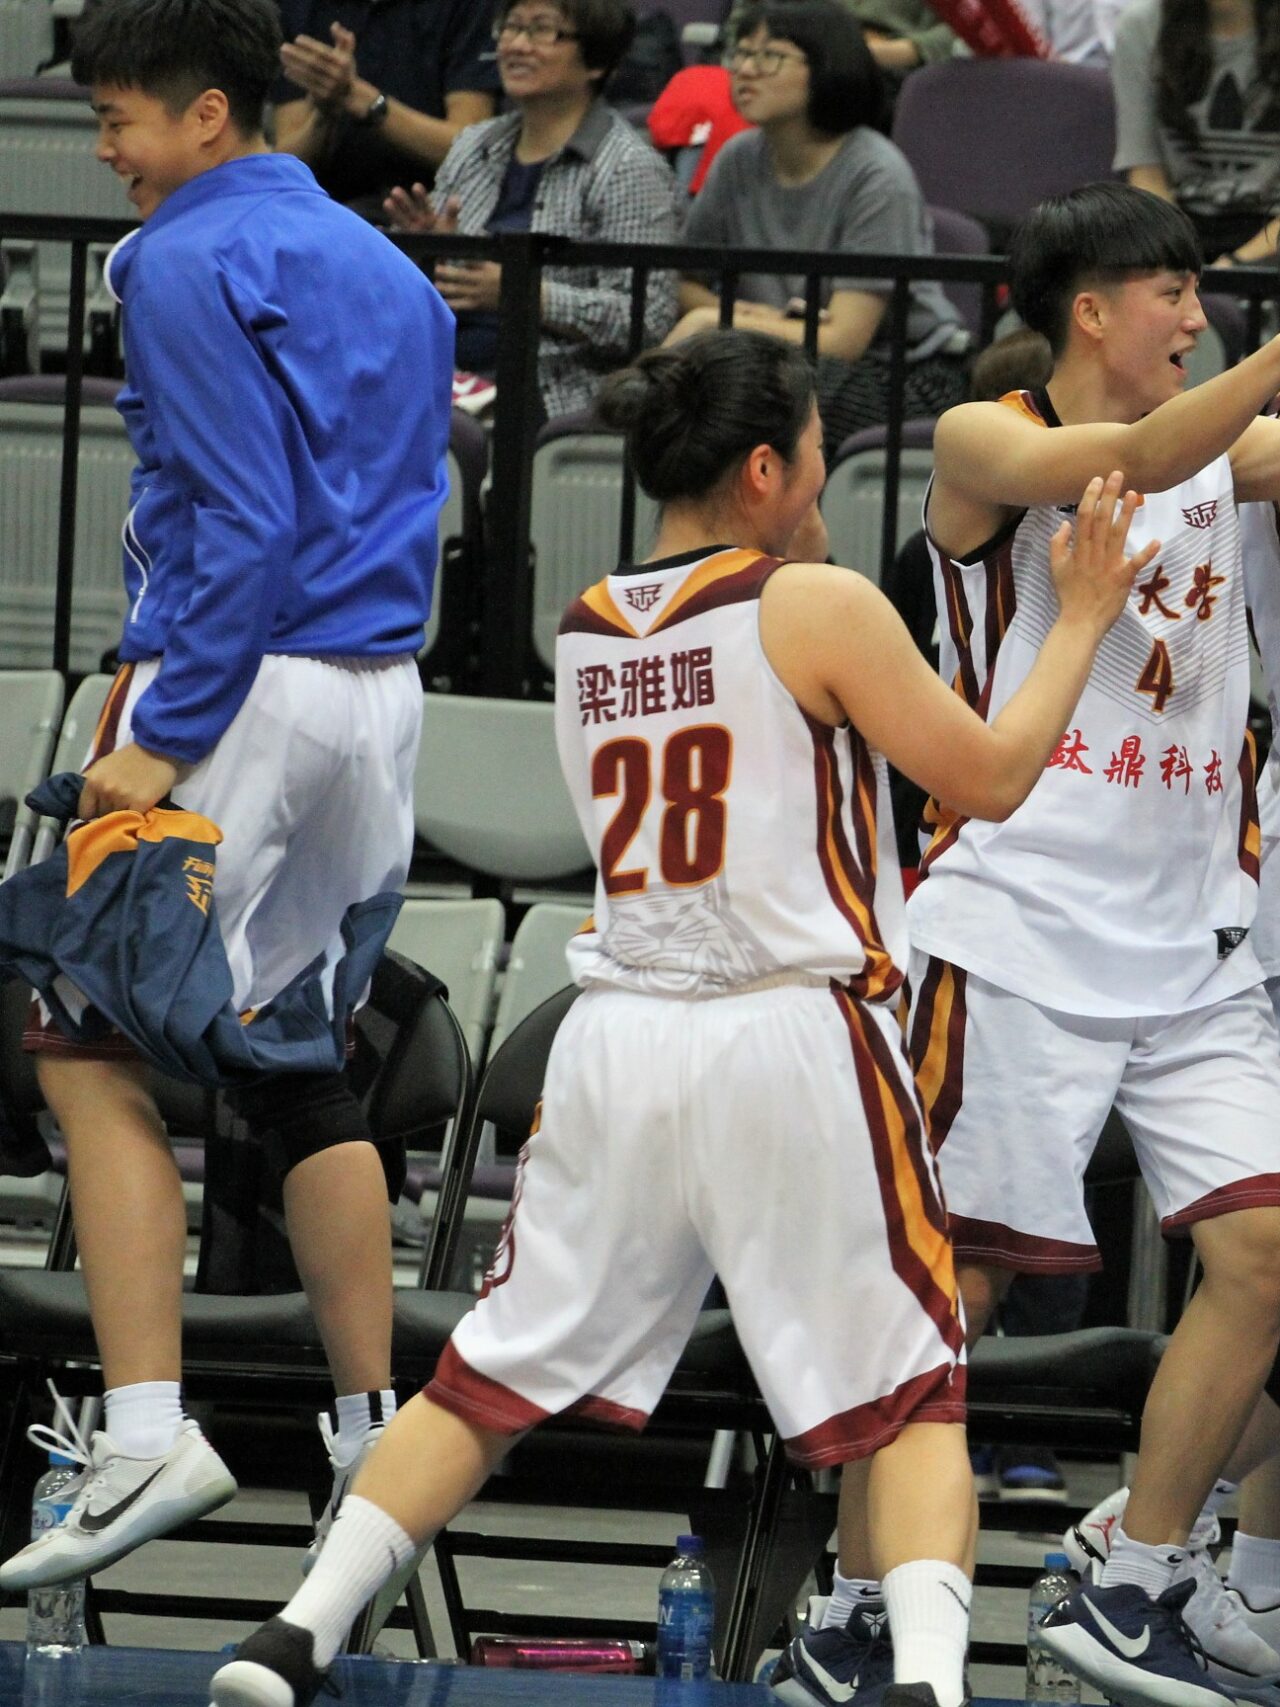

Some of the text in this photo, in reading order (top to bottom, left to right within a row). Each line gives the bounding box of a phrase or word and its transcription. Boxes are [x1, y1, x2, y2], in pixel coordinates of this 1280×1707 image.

[577, 646, 716, 727] 梁雅媚
[1135, 638, 1176, 715] 4
[591, 722, 734, 899] 28
